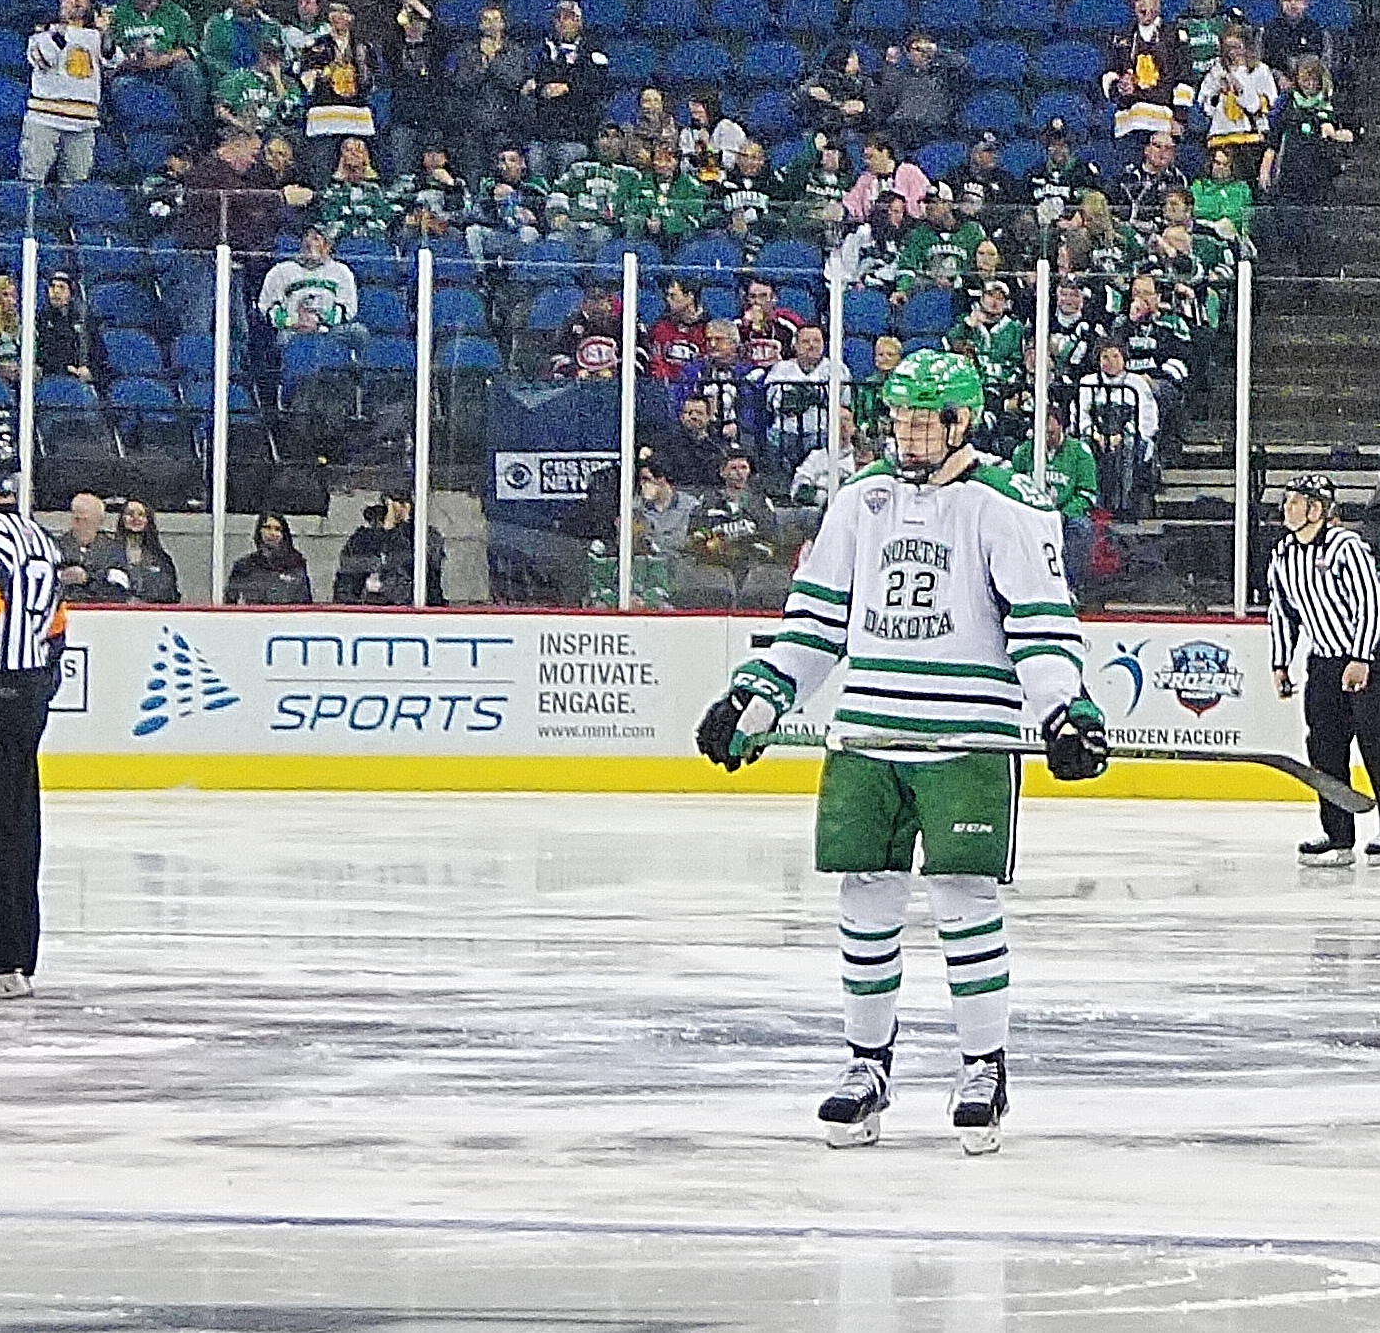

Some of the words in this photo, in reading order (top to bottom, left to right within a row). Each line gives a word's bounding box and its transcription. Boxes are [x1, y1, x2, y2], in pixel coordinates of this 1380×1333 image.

[880, 538, 953, 573] NORTH
[886, 570, 937, 608] 22
[862, 607, 955, 640] DAKOTA
[539, 633, 637, 656] INSPIRE.
[538, 663, 660, 687] MOTIVATE.
[269, 695, 509, 733] SPORTS
[539, 691, 637, 715] ENGAGE.
[537, 723, 657, 740] www.mmt.com
[1107, 727, 1169, 746] FROZEN
[1174, 729, 1242, 746] FACEOFF
